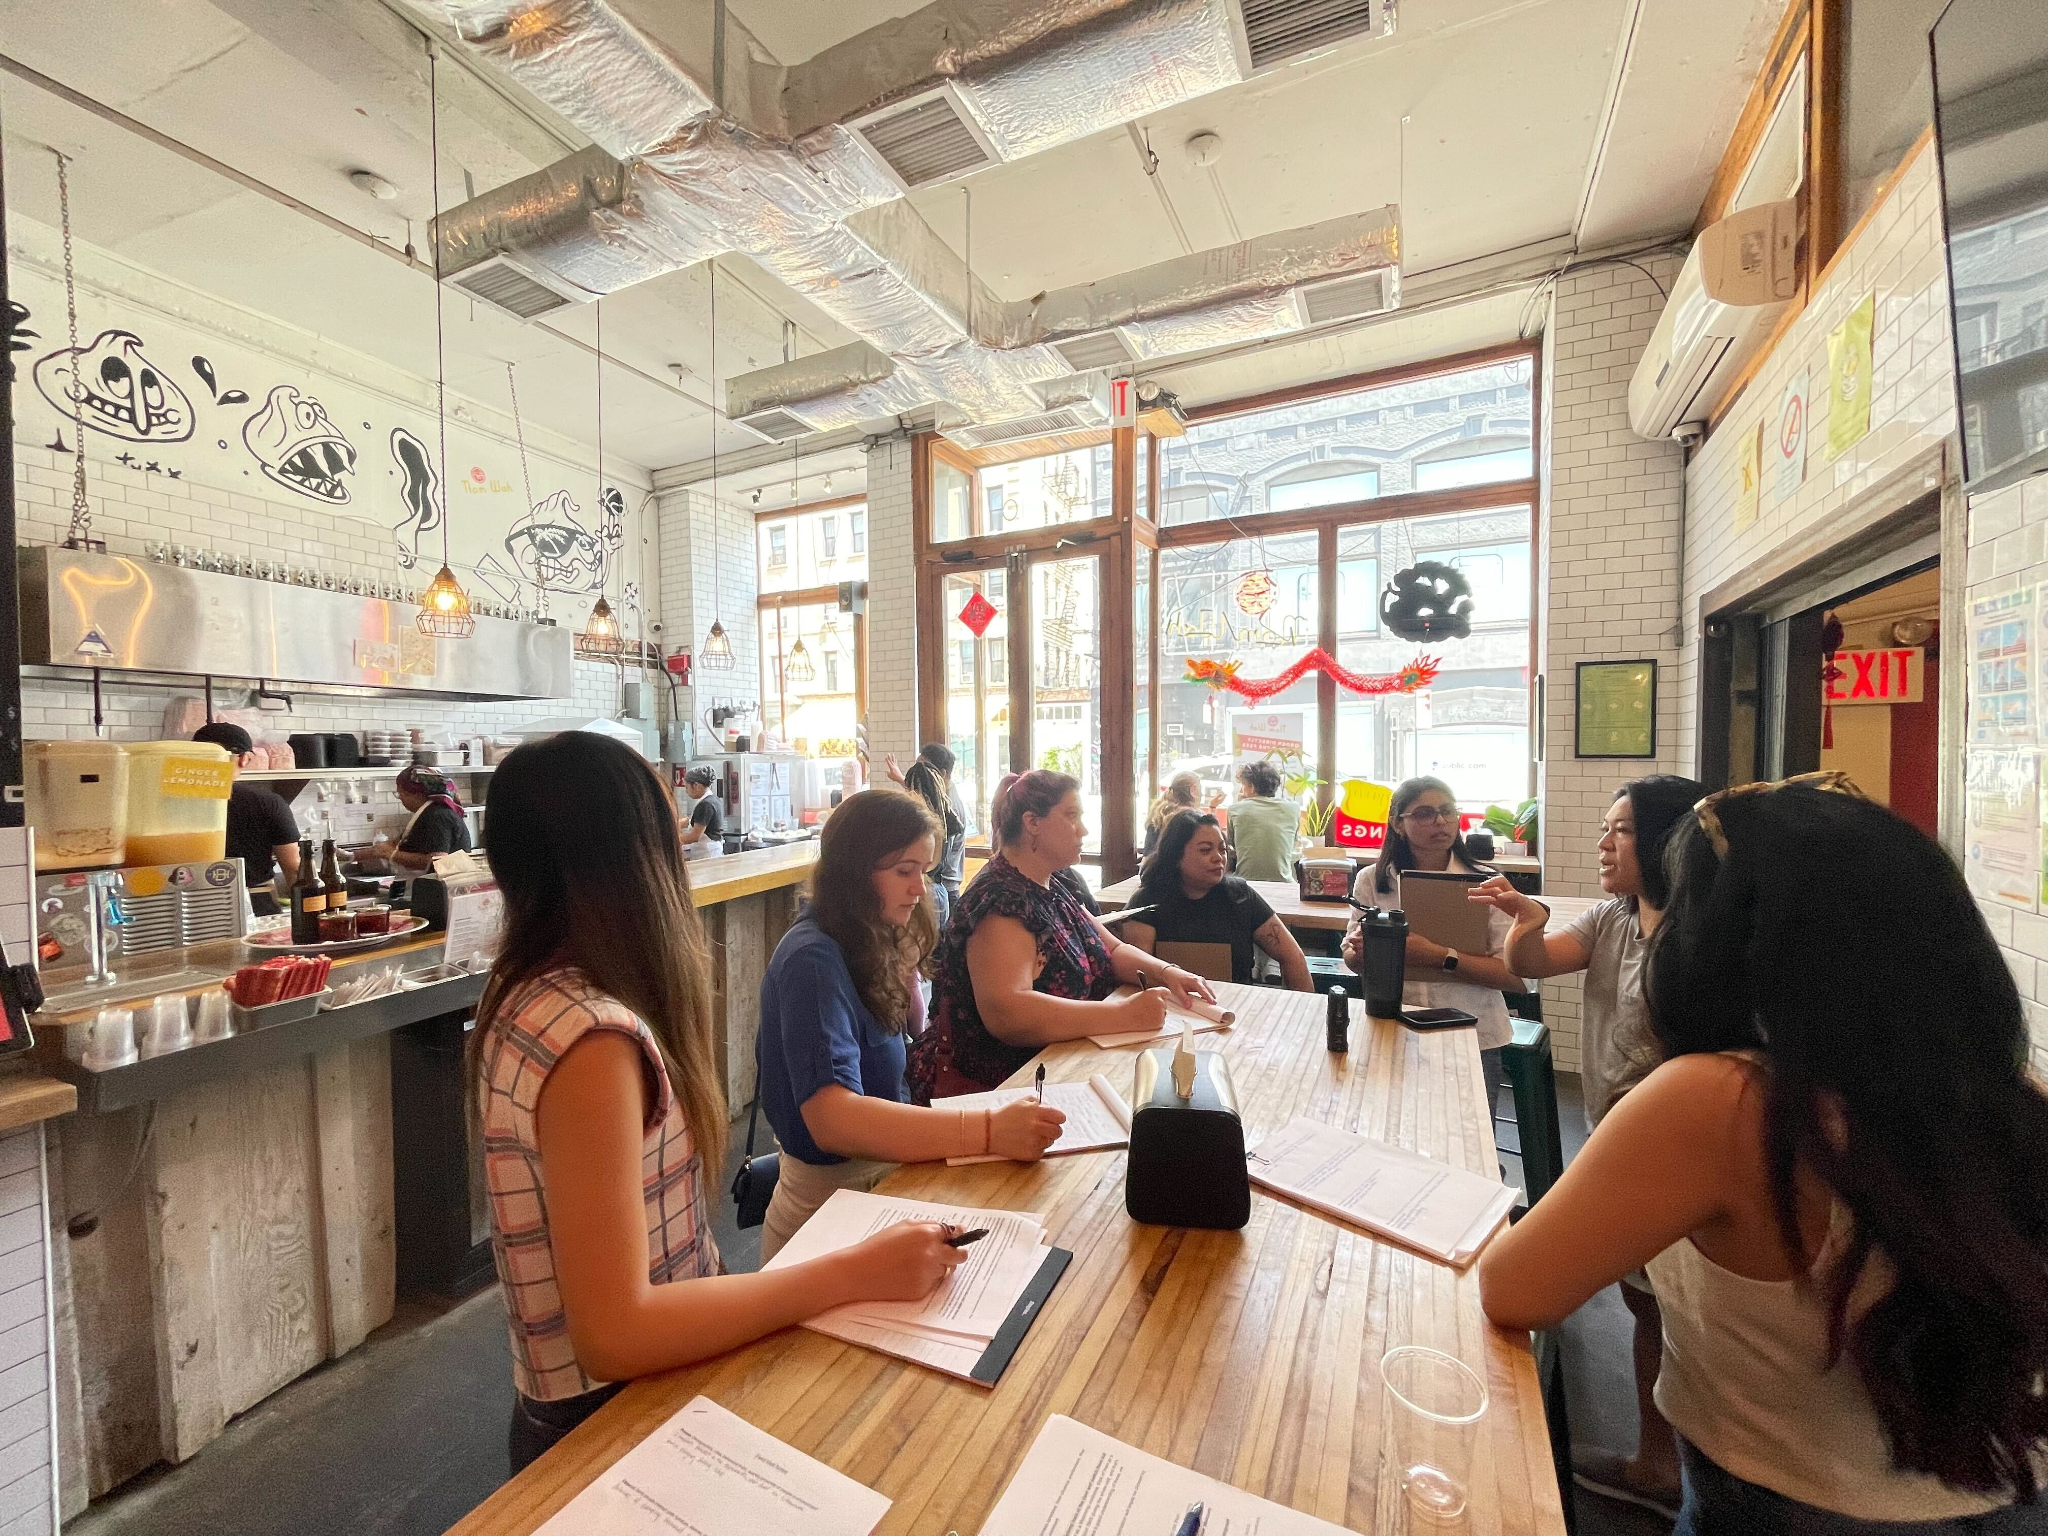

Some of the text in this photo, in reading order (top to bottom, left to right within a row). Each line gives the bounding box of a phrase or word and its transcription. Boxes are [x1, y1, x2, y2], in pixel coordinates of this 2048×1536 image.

[1111, 381, 1129, 417] IT
[461, 479, 514, 494] Nom Wah
[1825, 650, 1915, 699] EXIT
[175, 767, 220, 777] GINGER
[162, 776, 227, 788] LEMONADE
